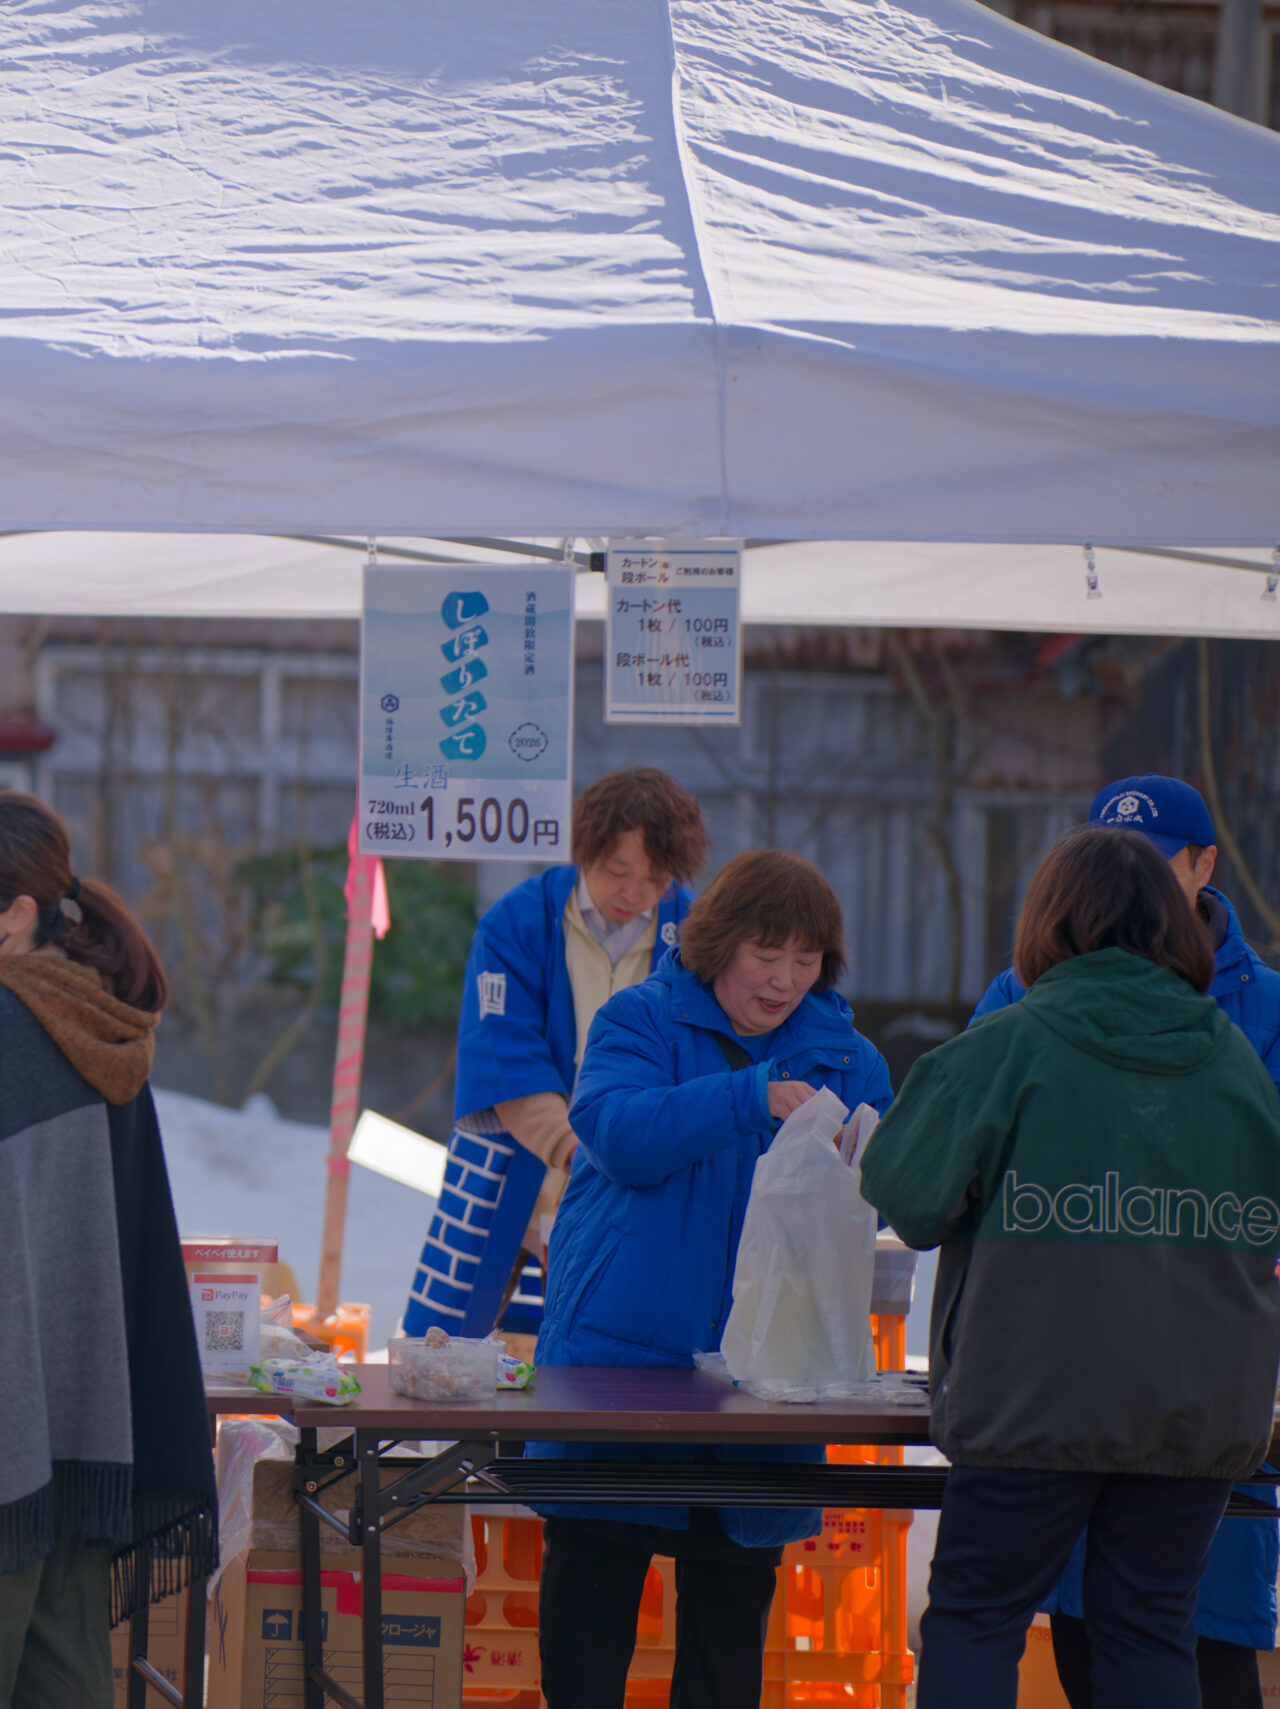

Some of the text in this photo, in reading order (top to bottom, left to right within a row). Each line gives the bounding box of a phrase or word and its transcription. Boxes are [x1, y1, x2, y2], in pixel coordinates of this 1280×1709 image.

[621, 557, 659, 569] カートン
[621, 571, 670, 584] 段ボール
[616, 599, 683, 614] カートン代
[638, 618, 662, 633] 1枚
[685, 618, 729, 633] 100円
[616, 652, 690, 668] 段ボール代
[452, 598, 483, 755] しぼりたて
[637, 672, 662, 687] 1枚
[683, 672, 729, 688] 100円
[515, 736, 542, 748] 2026
[394, 763, 449, 790] 生酒
[368, 799, 415, 816] 720ml
[420, 796, 560, 848] 1,500円
[365, 822, 415, 842] (税込)
[1003, 1170, 1280, 1245] balance
[194, 1247, 261, 1260] ペイペイ使えます
[215, 1289, 249, 1302] PayPay
